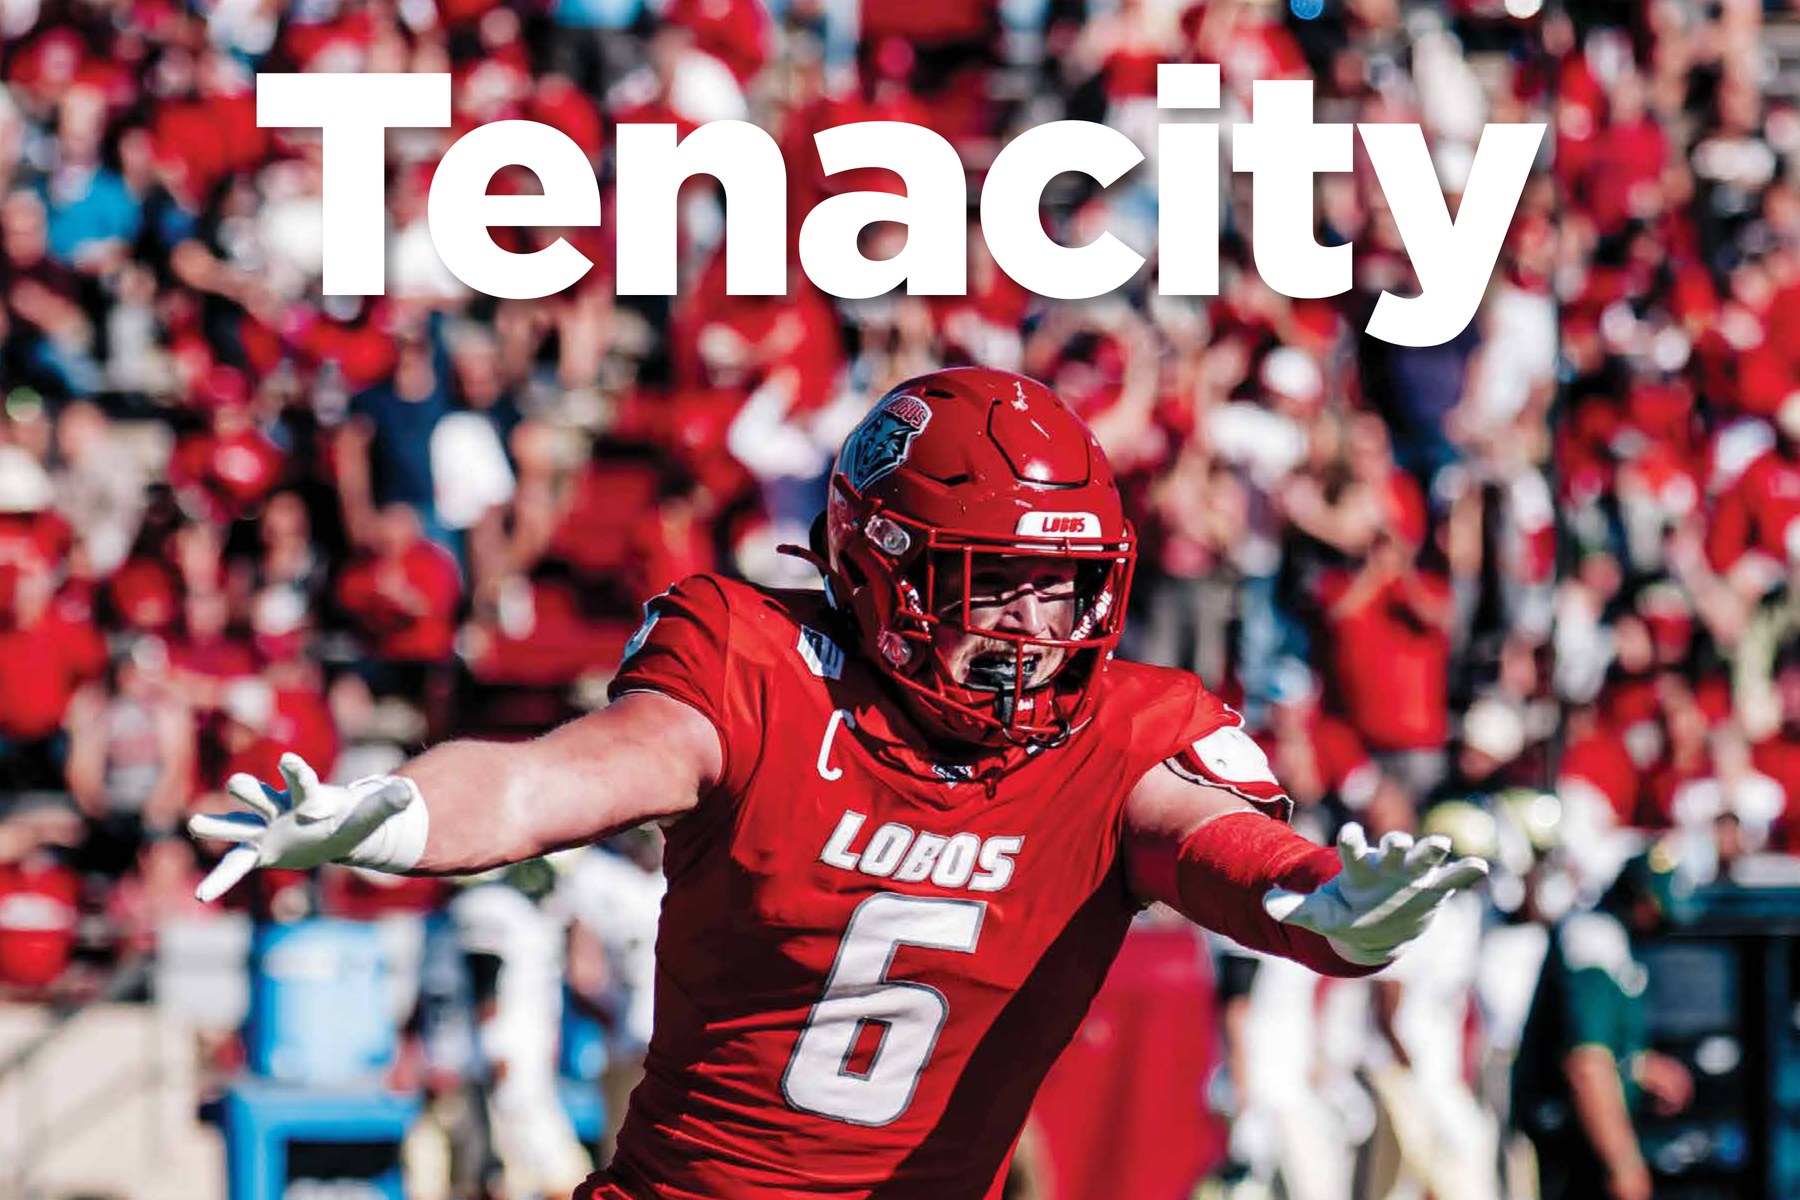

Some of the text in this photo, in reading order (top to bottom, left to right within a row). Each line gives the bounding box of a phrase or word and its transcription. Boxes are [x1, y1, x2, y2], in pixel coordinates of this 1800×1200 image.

[1041, 516, 1086, 533] LOBOS
[816, 708, 857, 782] C
[819, 809, 1026, 893] LOBOS
[780, 892, 988, 1128] 6
